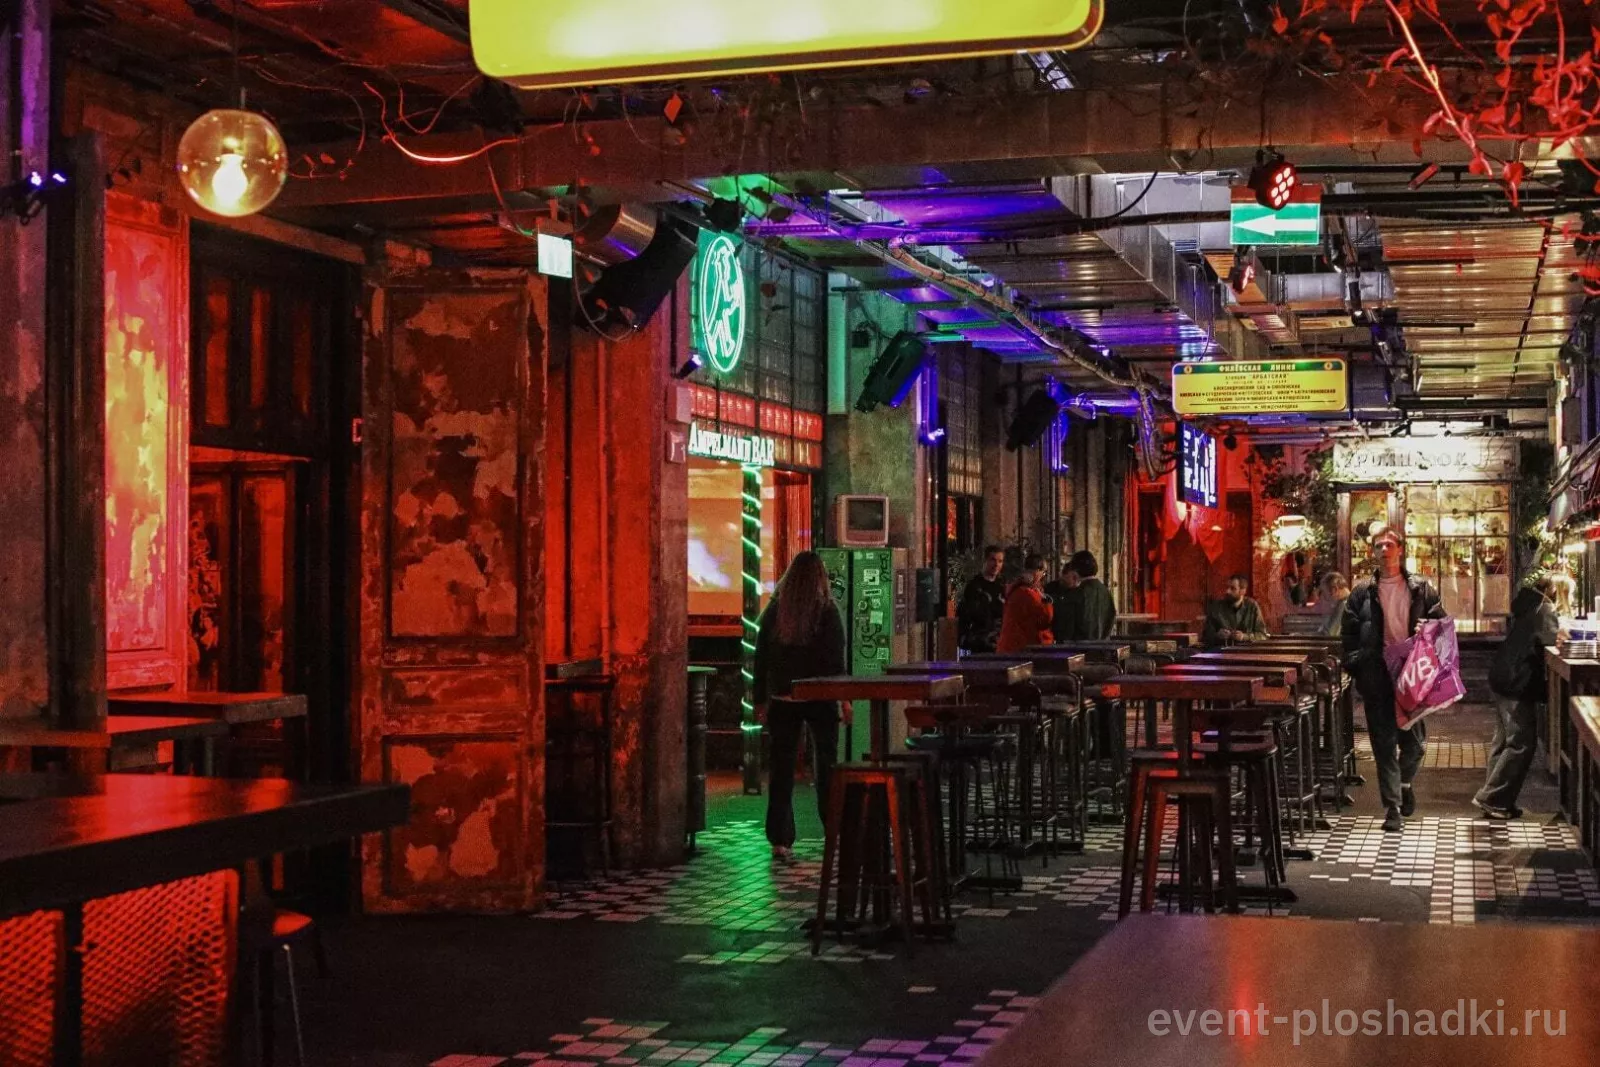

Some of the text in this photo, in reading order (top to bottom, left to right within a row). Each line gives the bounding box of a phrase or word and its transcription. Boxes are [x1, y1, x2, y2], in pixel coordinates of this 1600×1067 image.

[1219, 363, 1296, 372] ФИЛЁВСКАЯ ЛИНИЯ
[752, 435, 775, 467] BAR
